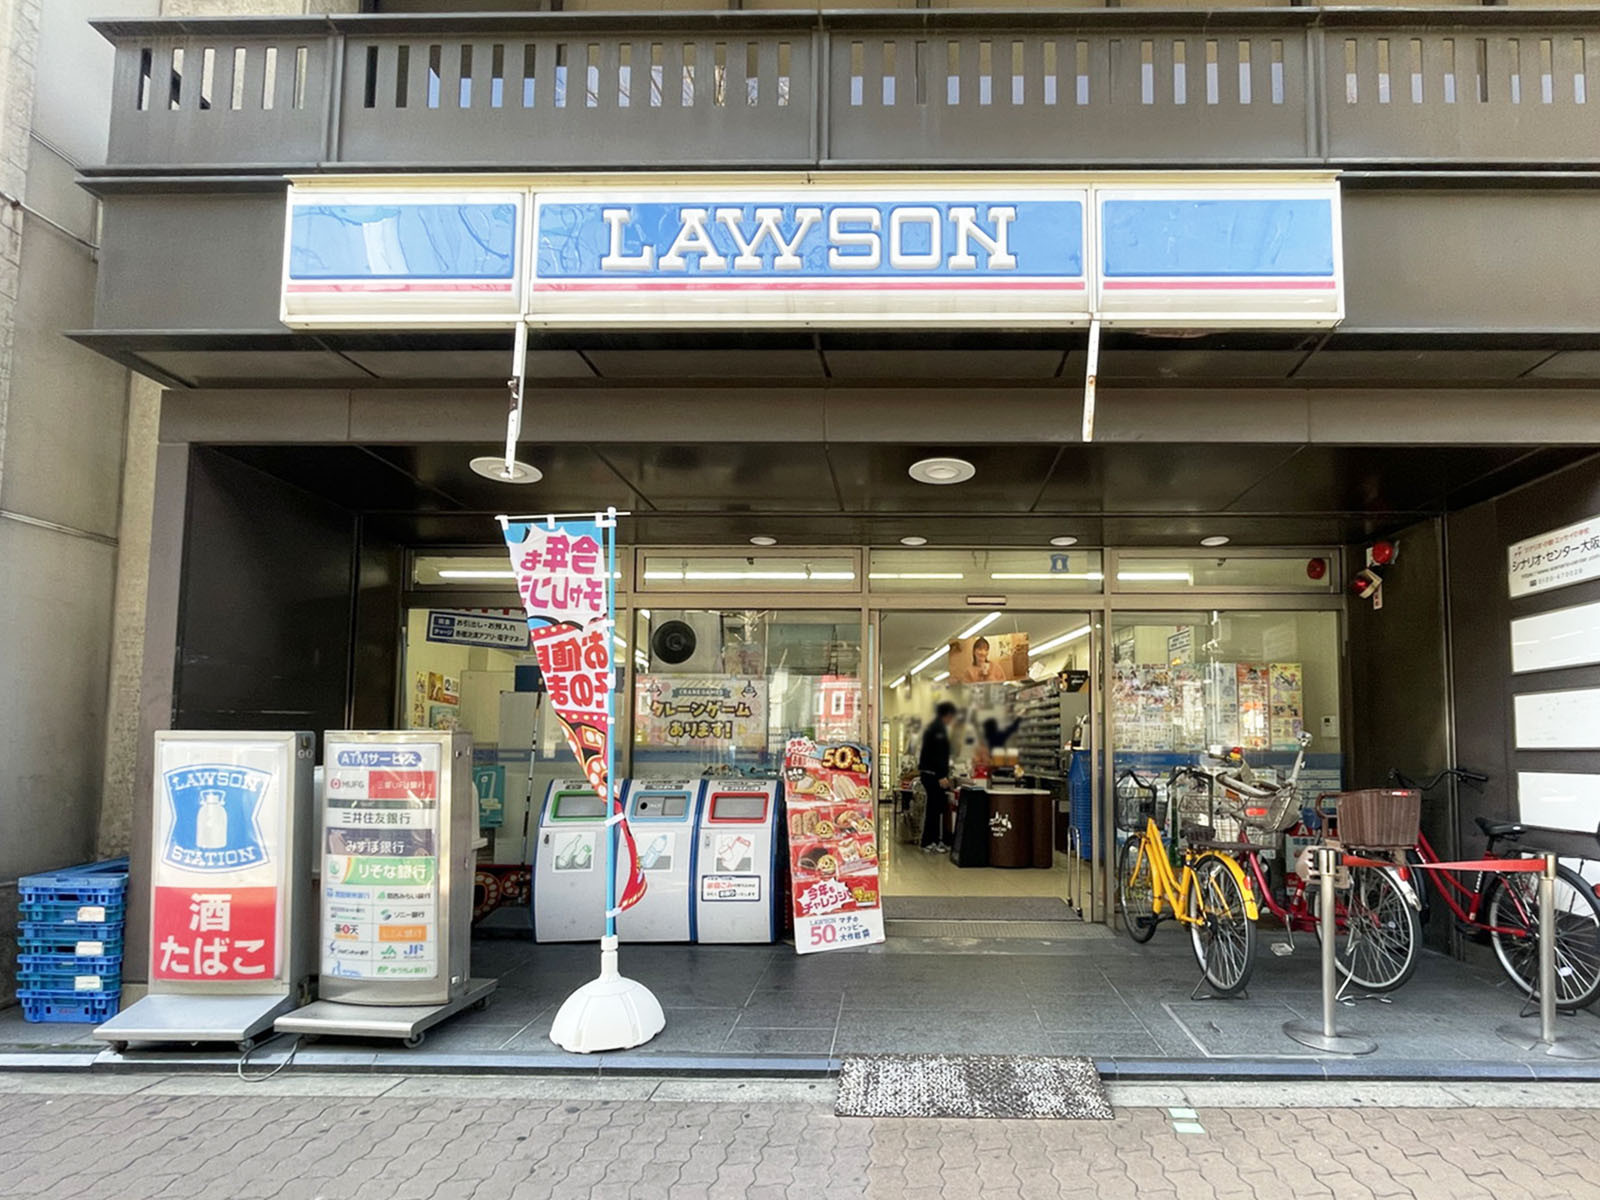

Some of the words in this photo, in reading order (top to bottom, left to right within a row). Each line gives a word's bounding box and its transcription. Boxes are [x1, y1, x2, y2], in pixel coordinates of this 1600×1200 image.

[601, 206, 1017, 271] LAWSON
[651, 701, 752, 719] クレーンゲーム
[341, 752, 418, 765] ATMサービス
[173, 772, 259, 791] LAWSON
[342, 812, 411, 825] 三井住友銀行
[172, 845, 257, 866] STATION
[345, 840, 405, 854] みずほ銀行
[359, 864, 427, 878] りそな銀行
[807, 884, 835, 901] 今年も
[189, 893, 233, 932] 酒
[160, 935, 266, 976] たばこ
